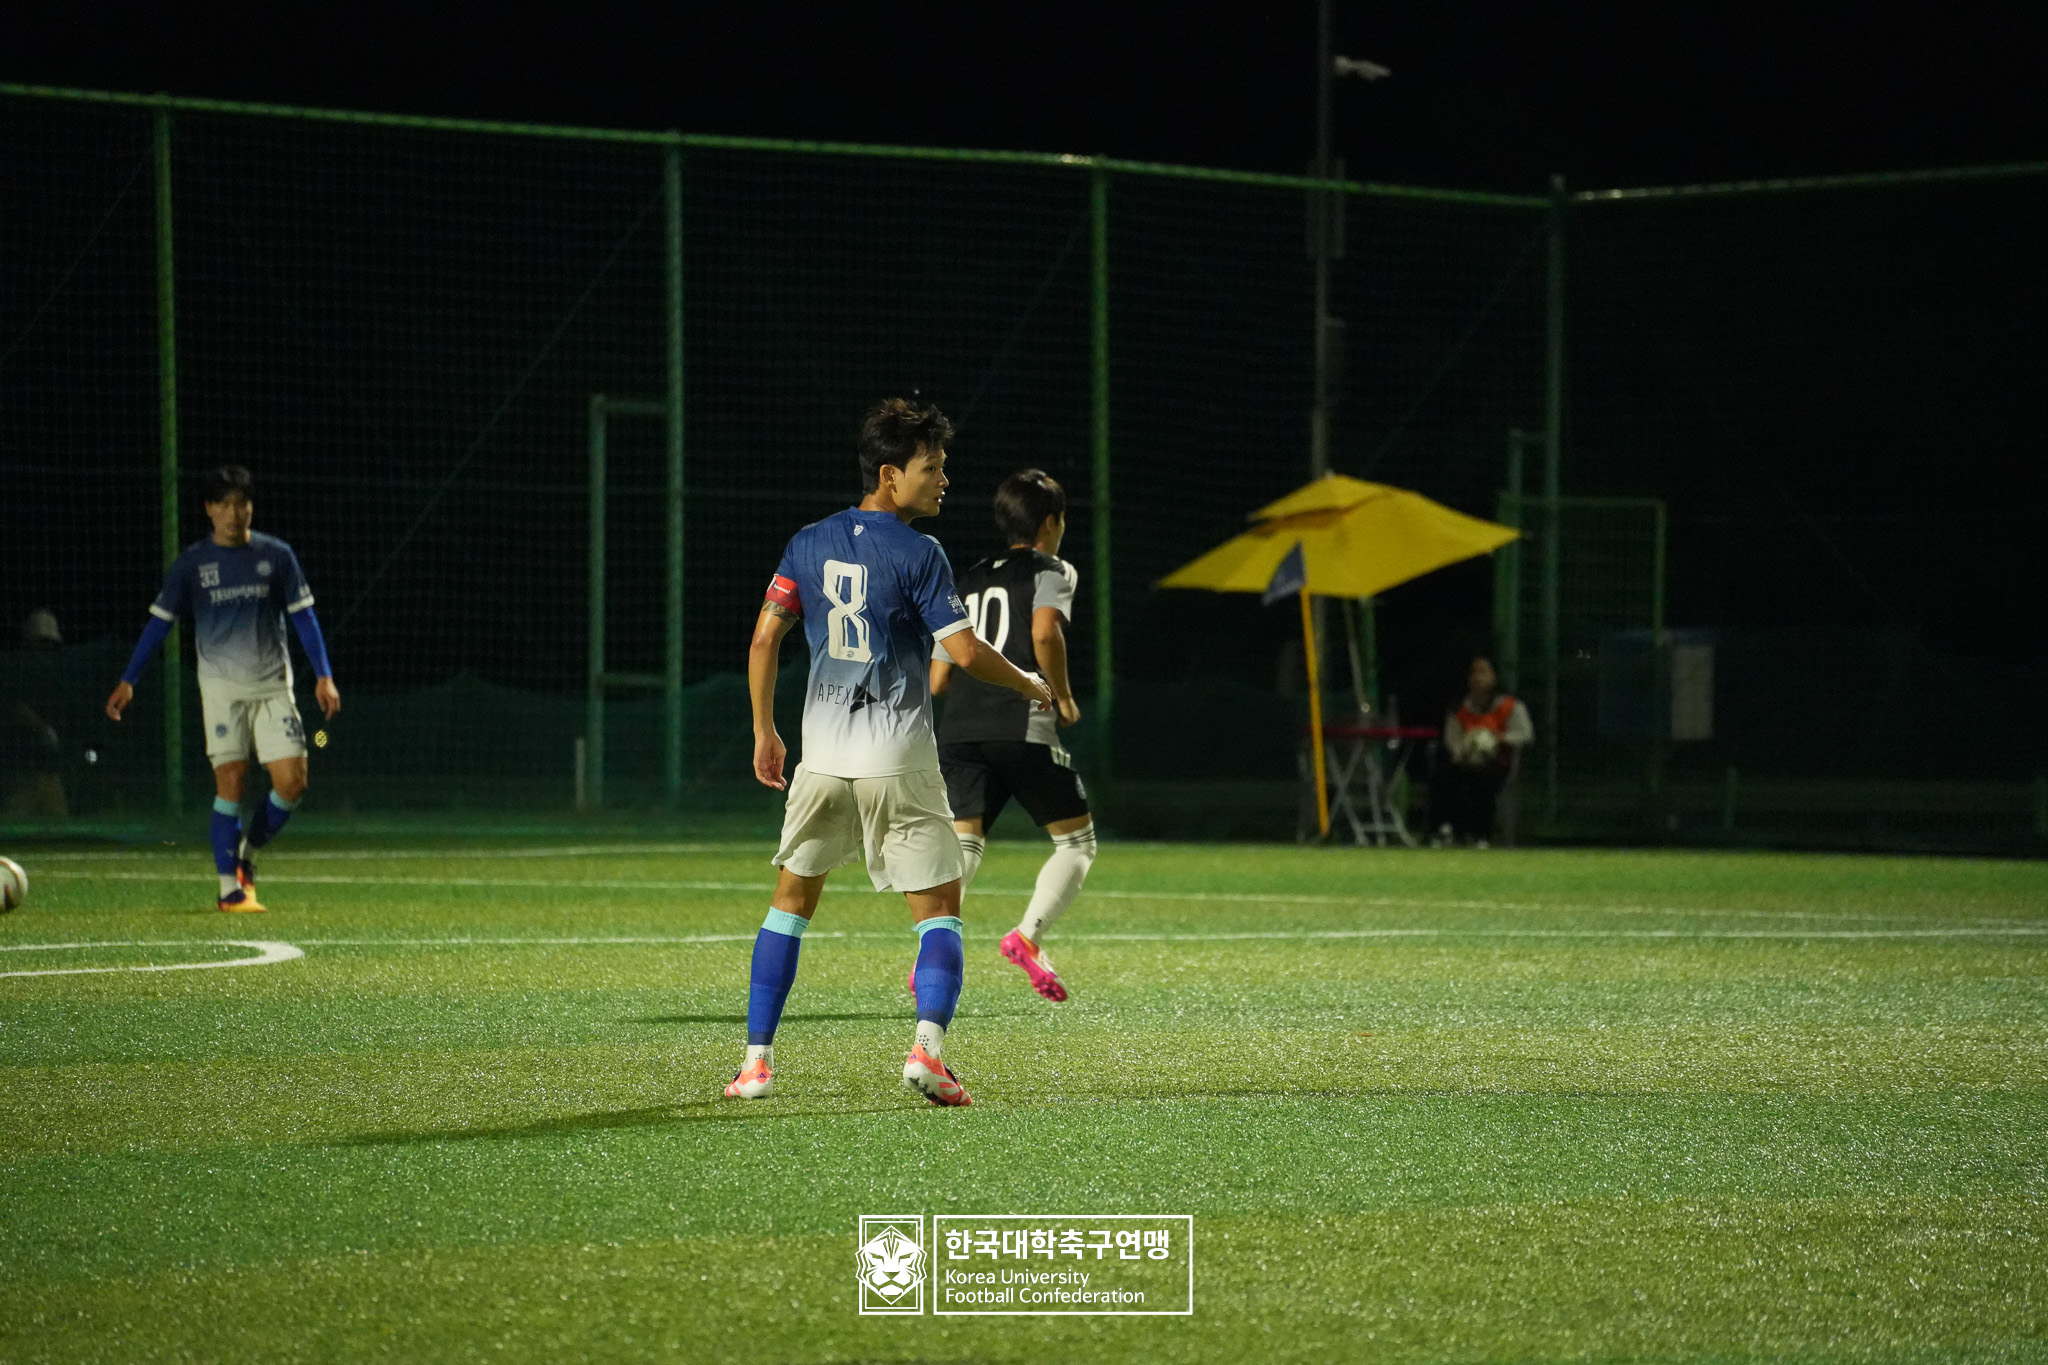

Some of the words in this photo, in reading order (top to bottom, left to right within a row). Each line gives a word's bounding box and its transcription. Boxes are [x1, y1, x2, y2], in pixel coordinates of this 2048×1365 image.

[199, 569, 221, 588] 33
[823, 559, 874, 663] 8
[964, 586, 1010, 653] 10
[817, 682, 852, 706] APEX
